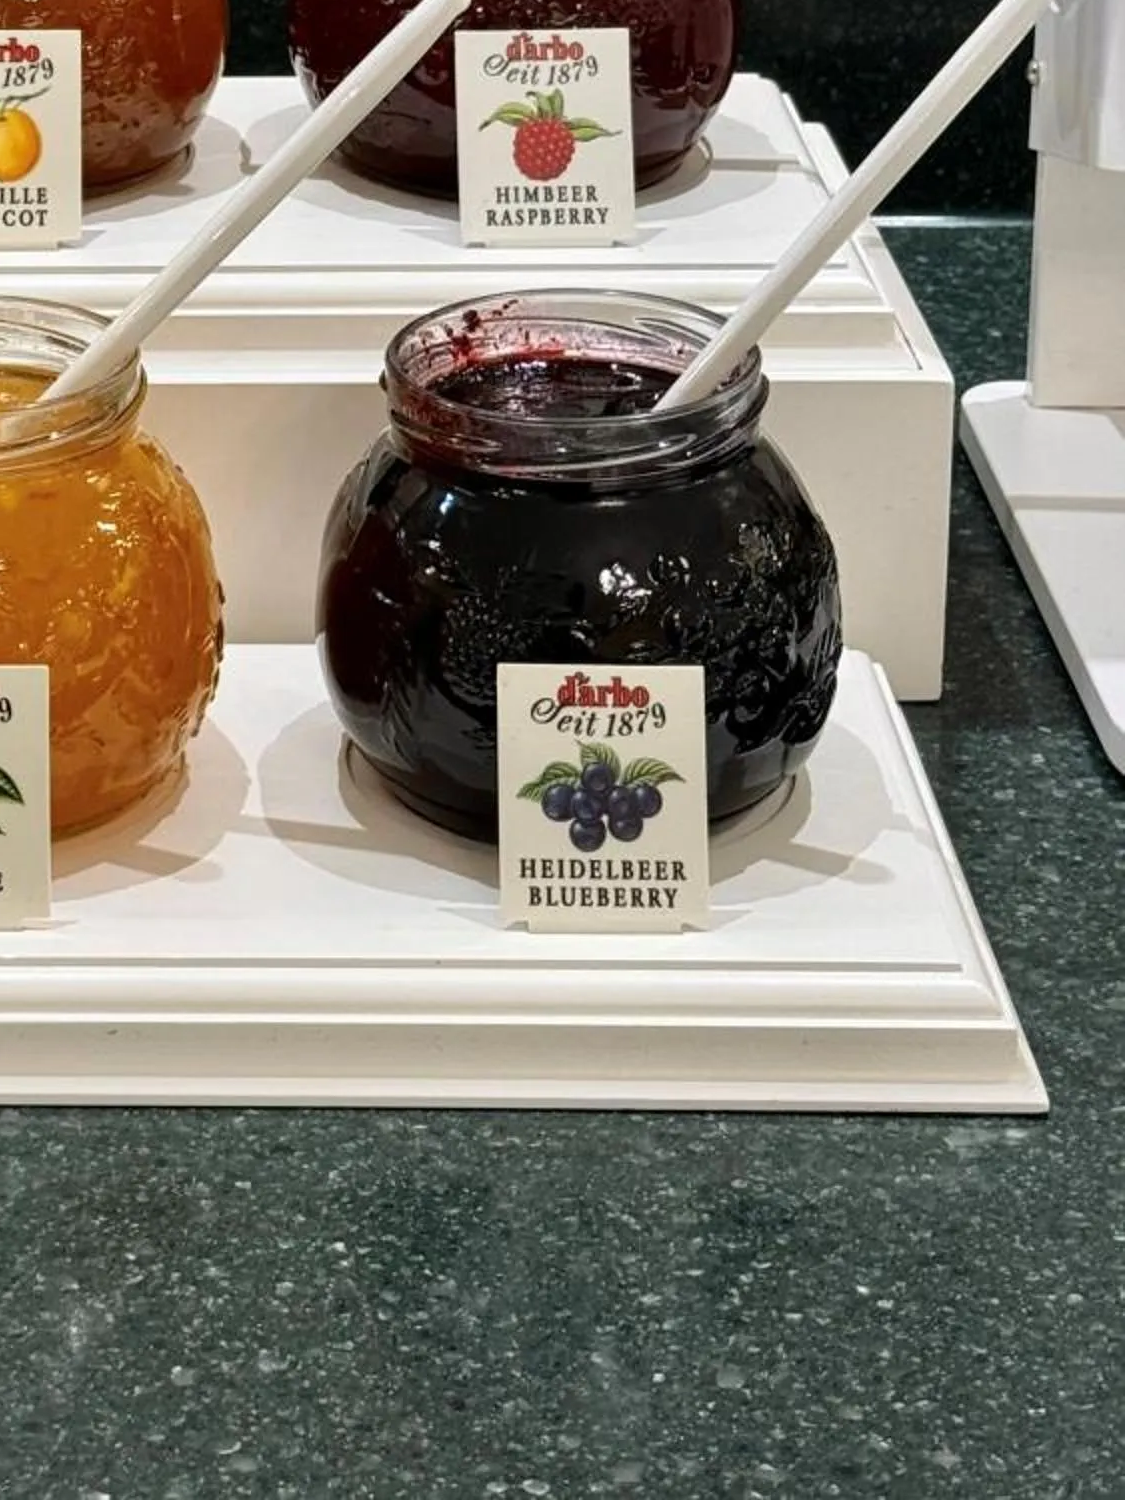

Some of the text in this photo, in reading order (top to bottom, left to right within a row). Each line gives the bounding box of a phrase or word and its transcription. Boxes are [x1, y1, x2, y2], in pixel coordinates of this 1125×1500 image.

[3, 58, 54, 88] 1879
[483, 54, 599, 86] Seit 1879
[495, 185, 599, 204] HIMBEER
[486, 208, 609, 227] RASPBERRY
[530, 697, 666, 737] Seit 1879
[520, 858, 687, 881] HEIDELBEER
[528, 886, 678, 909] BLUEBERRY
